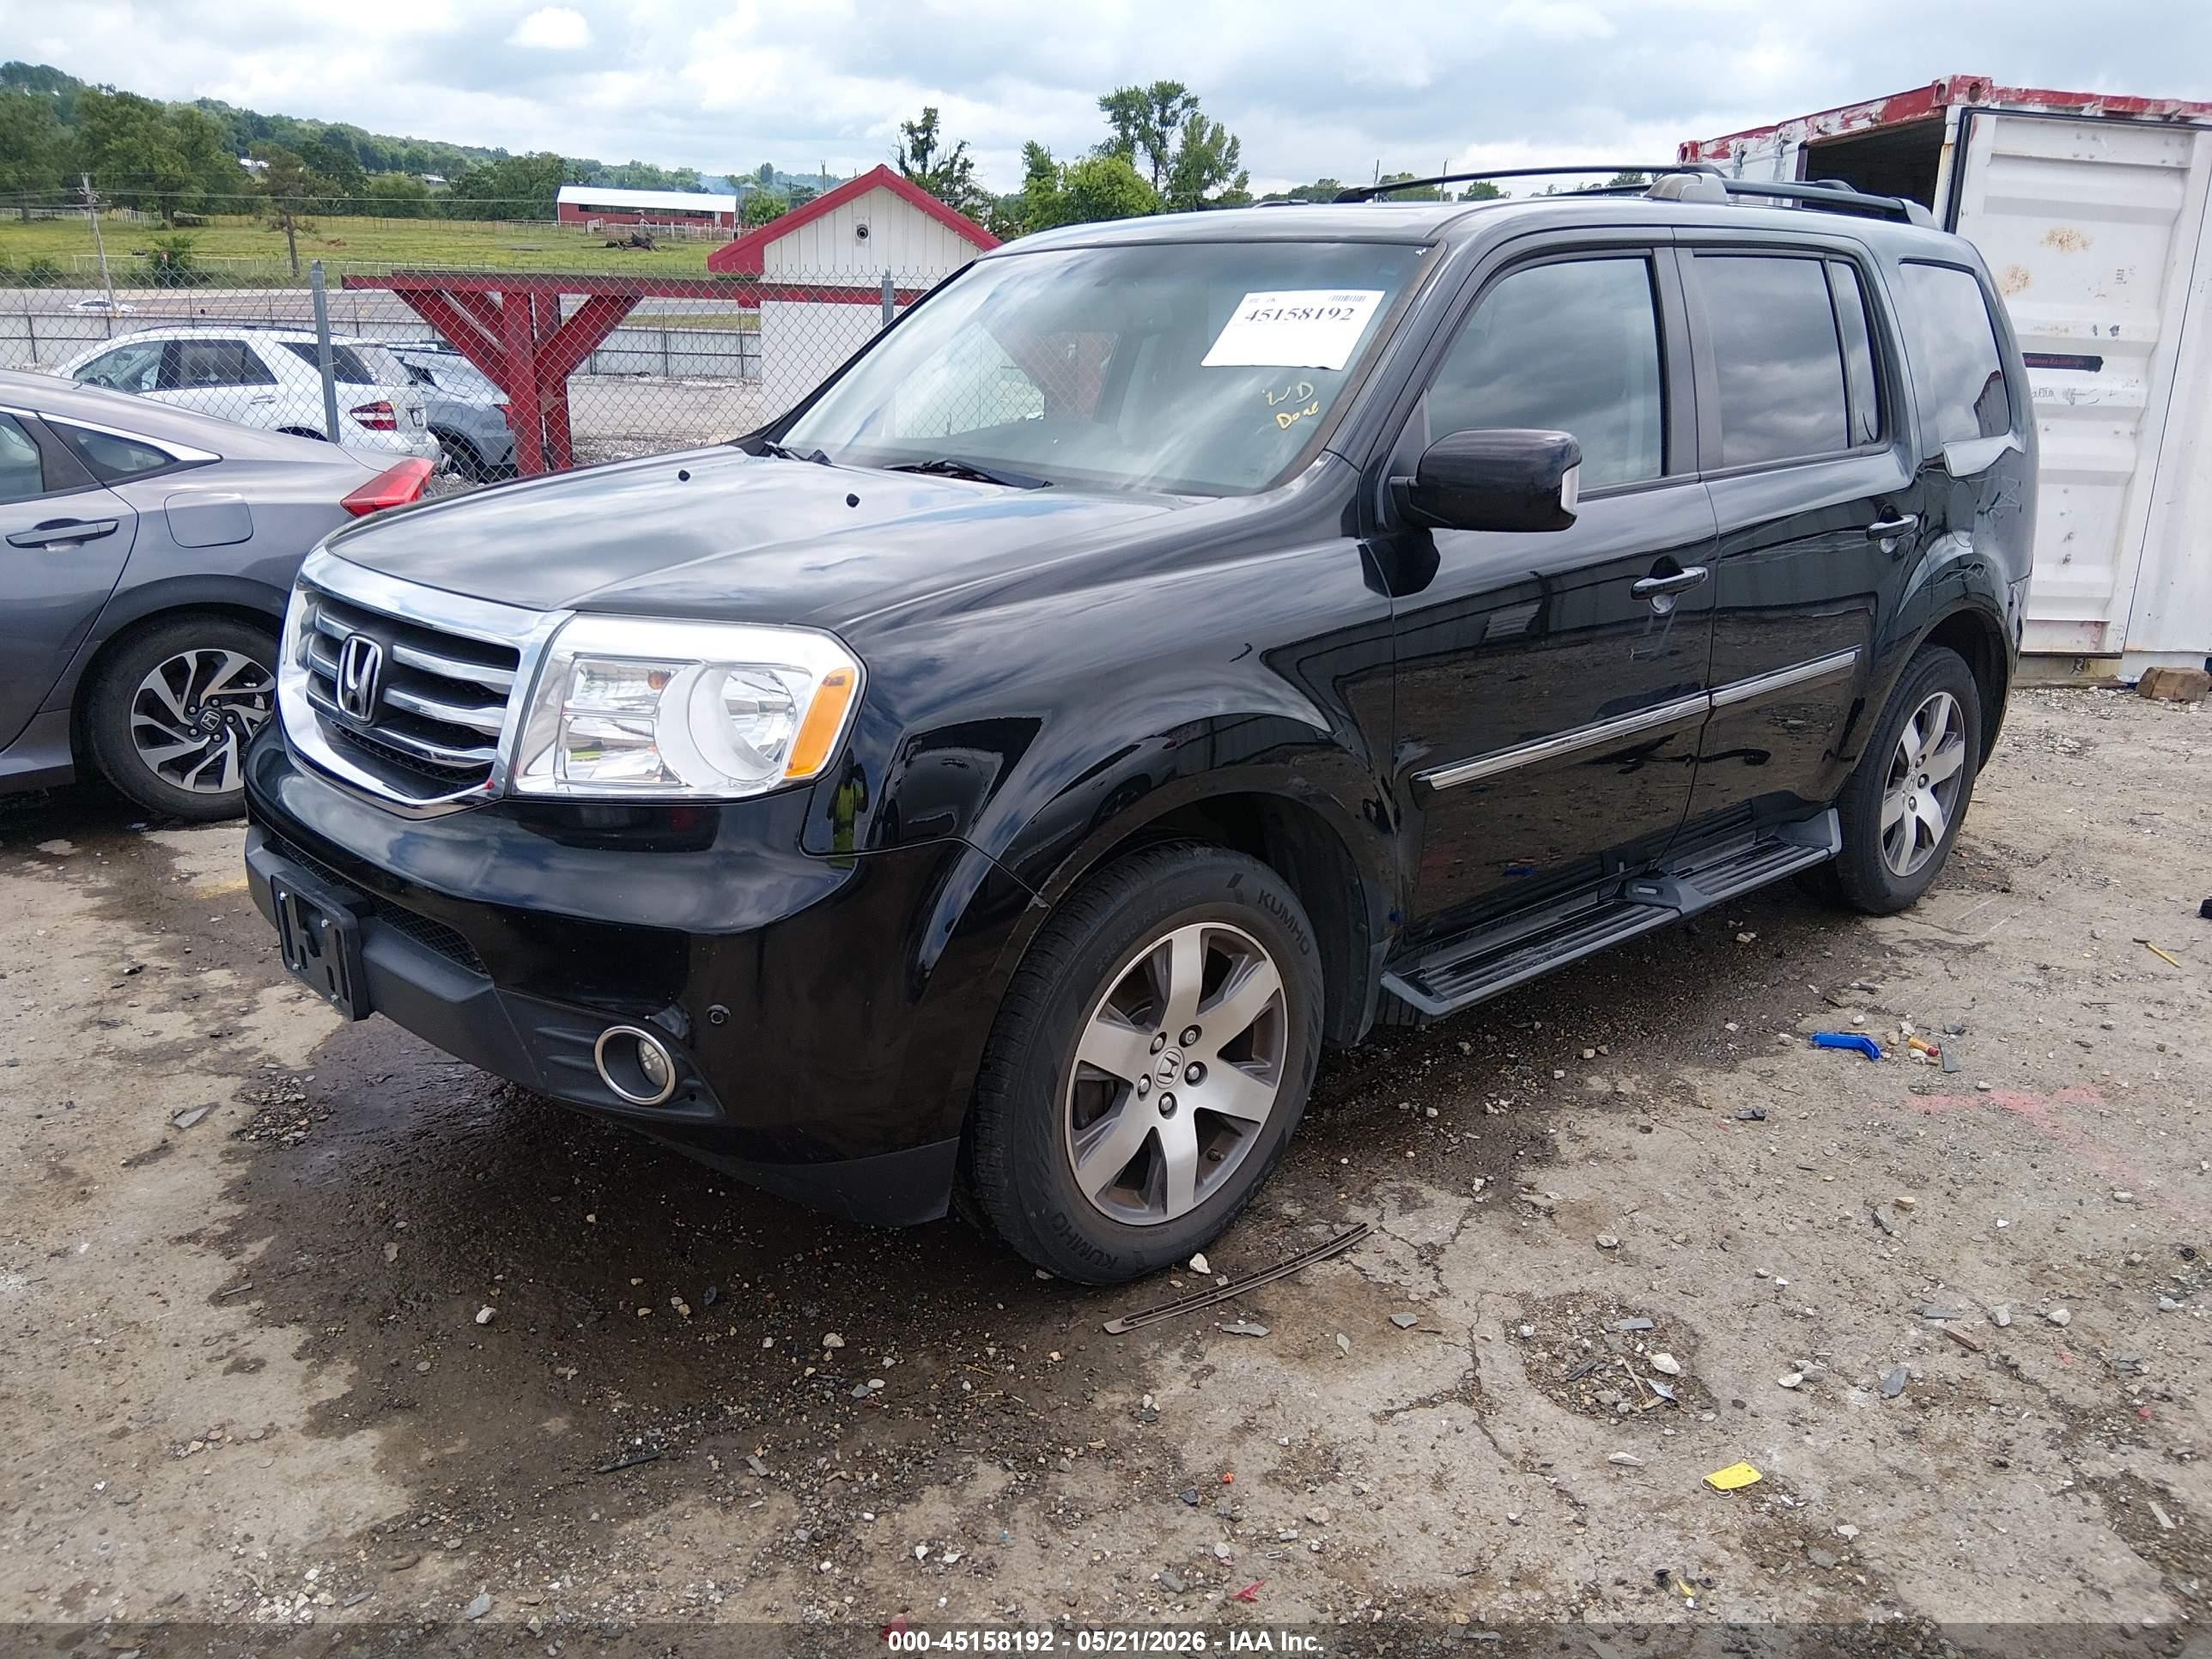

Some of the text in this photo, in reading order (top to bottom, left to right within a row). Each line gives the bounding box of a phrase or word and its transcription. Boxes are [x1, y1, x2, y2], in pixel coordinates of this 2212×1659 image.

[1244, 307, 1355, 322] 45158192
[1257, 889, 1310, 957] KUMHO
[1054, 1211, 1121, 1270] KUMHO
